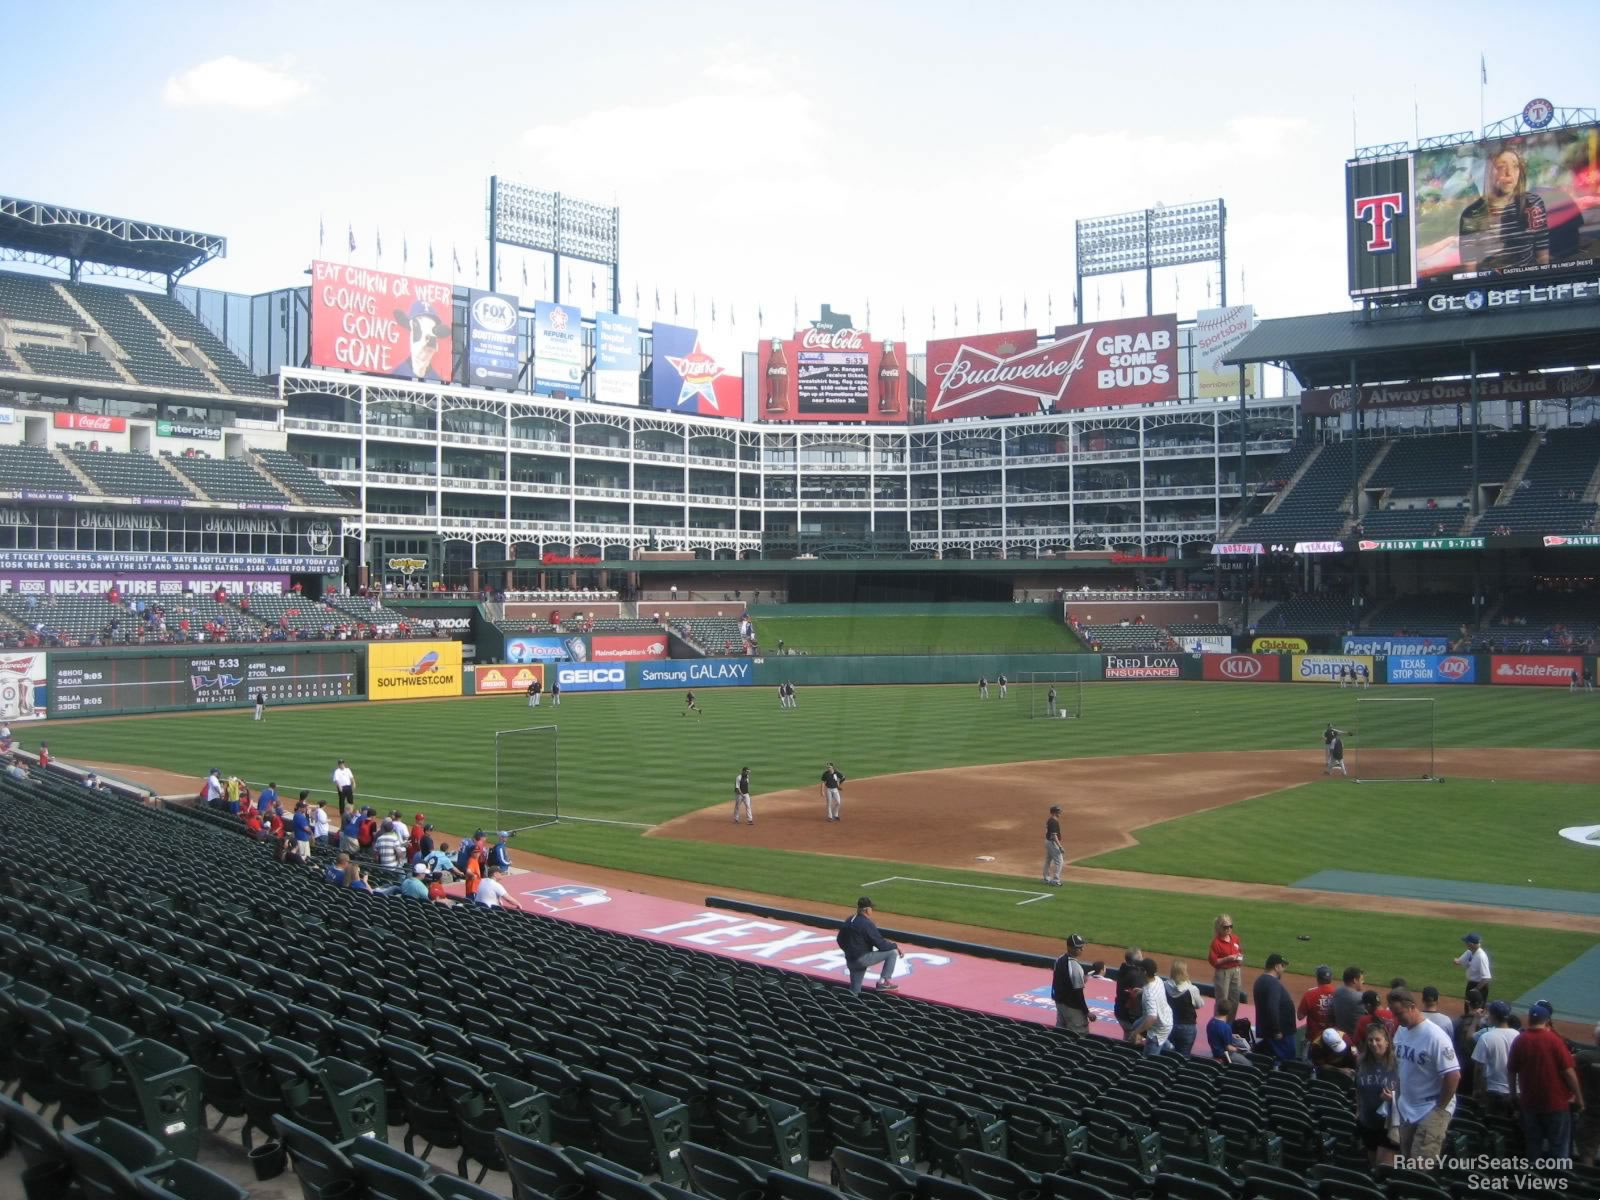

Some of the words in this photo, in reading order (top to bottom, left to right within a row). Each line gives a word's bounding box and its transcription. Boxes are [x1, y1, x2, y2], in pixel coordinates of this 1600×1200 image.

[1354, 192, 1402, 252] T
[316, 263, 341, 281] EAT
[345, 267, 388, 297] CHIKIN
[392, 277, 410, 297] OR
[415, 284, 451, 305] WEER
[323, 285, 377, 315] GOING
[482, 303, 507, 319] FOX
[342, 312, 400, 344] GOING
[816, 322, 834, 331] Enjoy
[543, 330, 575, 341] REPUBLIC
[803, 327, 864, 350] Coca-Cola
[1199, 319, 1249, 349] SportsDay
[1096, 330, 1171, 356] GRAB
[335, 336, 394, 371] GONE
[1108, 351, 1157, 368] SOME
[845, 357, 864, 365] 5:33
[934, 353, 1084, 391] Budweiser
[1096, 364, 1170, 390] BUDS
[1369, 387, 1430, 404] Always
[1432, 384, 1465, 399] One
[1503, 377, 1546, 394] Kind
[79, 415, 113, 429] Coca-Cola
[160, 424, 221, 437] enterprise
[12, 491, 23, 500] 34
[27, 492, 47, 500] NOLAN
[48, 493, 63, 501] RYAN
[81, 510, 112, 528] JACK
[205, 517, 234, 532] JACK
[1223, 544, 1252, 554] BOSTON
[1306, 543, 1332, 552] TEXAS
[1380, 541, 1418, 550] FRIDAY
[1422, 541, 1444, 549] MAY
[13, 553, 44, 561] TICKET
[47, 554, 95, 563] VOUCHERS,
[97, 554, 149, 563] SWEATSHIRT
[151, 556, 170, 564] BAG,
[172, 556, 197, 564] WATER
[200, 556, 227, 564] BOTTLE
[246, 557, 269, 565] MORE.
[294, 558, 304, 566] UP
[305, 558, 327, 566] TODAY
[27, 562, 51, 570] NEAR
[54, 562, 74, 570] SEC.
[76, 562, 88, 570] 30
[90, 562, 102, 570] OR
[119, 563, 135, 571] THE
[138, 563, 152, 571] 1ST
[155, 563, 172, 571] AND
[175, 563, 190, 571] 3RD
[292, 565, 306, 573] FOR
[326, 566, 340, 574] $20
[50, 580, 113, 594] NEXEN
[116, 580, 157, 594] TIRE
[189, 580, 243, 594] NEXEN
[528, 646, 565, 656] TOTAL
[1260, 640, 1300, 650] Chicken
[191, 659, 217, 667] OFFICIAL
[218, 658, 240, 668] 5:33
[269, 665, 286, 673] 7:40
[1107, 656, 1141, 669] FRED
[1144, 655, 1178, 669] LOYA
[1227, 660, 1255, 674] KIA
[1400, 659, 1425, 669] TEXAS
[1443, 660, 1465, 674] DQ
[84, 672, 103, 680] 9:05
[558, 668, 625, 684] GEICO
[642, 669, 687, 682] Samsung
[690, 663, 749, 679] GALAXY
[1107, 668, 1178, 678] INSURANCE
[1393, 669, 1412, 679] STOP
[1414, 668, 1433, 679] SIGN
[377, 675, 454, 688] SOUTHWEST.COM
[224, 688, 235, 696] TEX
[84, 697, 103, 705] 9:05
